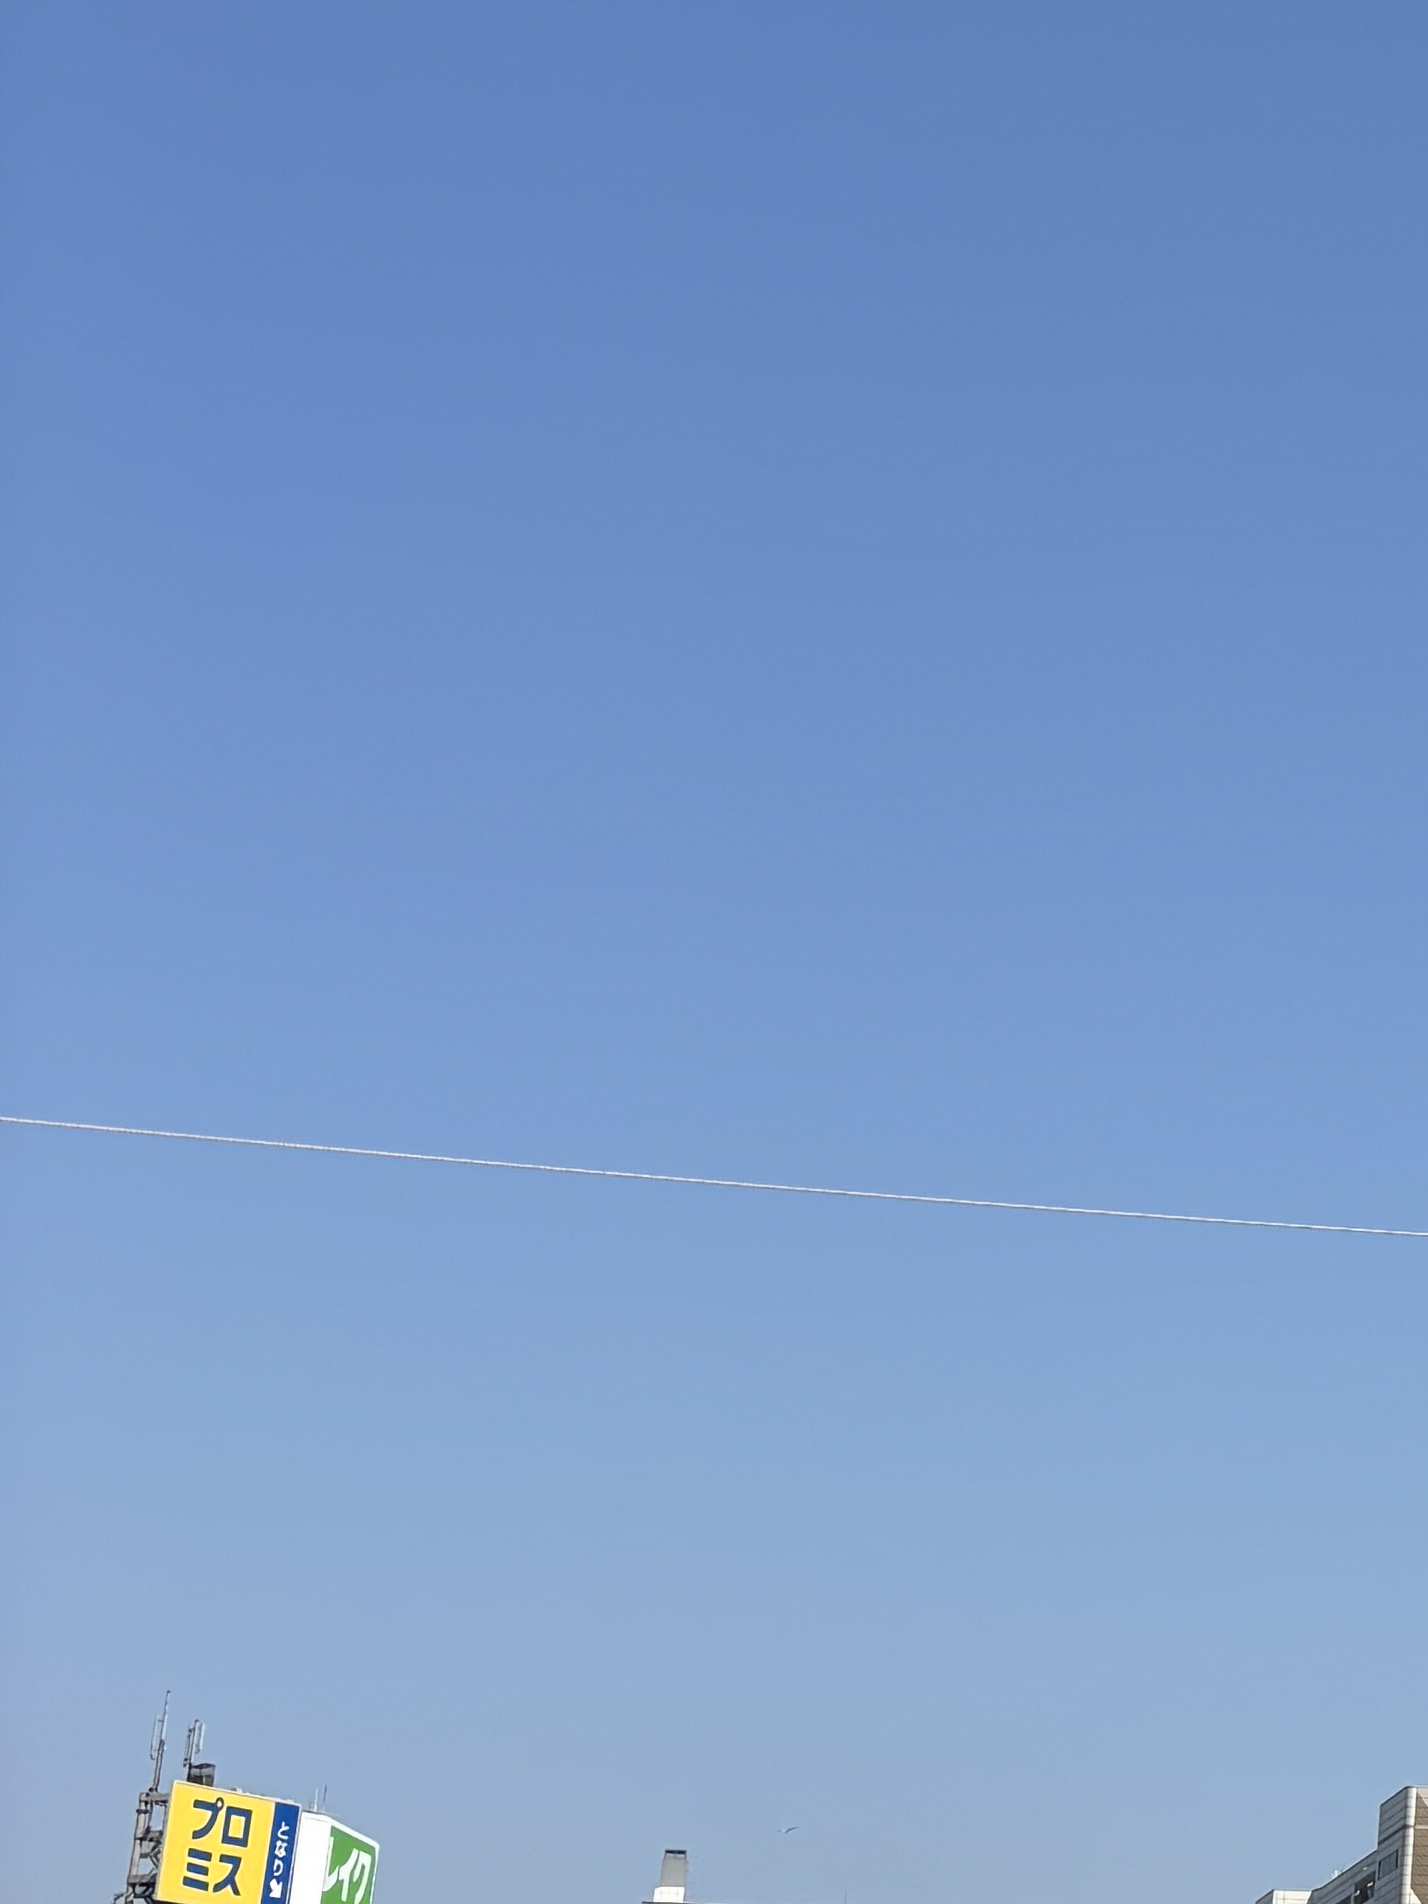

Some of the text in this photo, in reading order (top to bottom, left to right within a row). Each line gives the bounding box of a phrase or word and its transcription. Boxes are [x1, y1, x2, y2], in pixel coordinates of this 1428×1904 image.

[193, 1797, 253, 1848] プロ
[182, 1847, 243, 1897] ミス
[272, 1821, 290, 1877] となり
